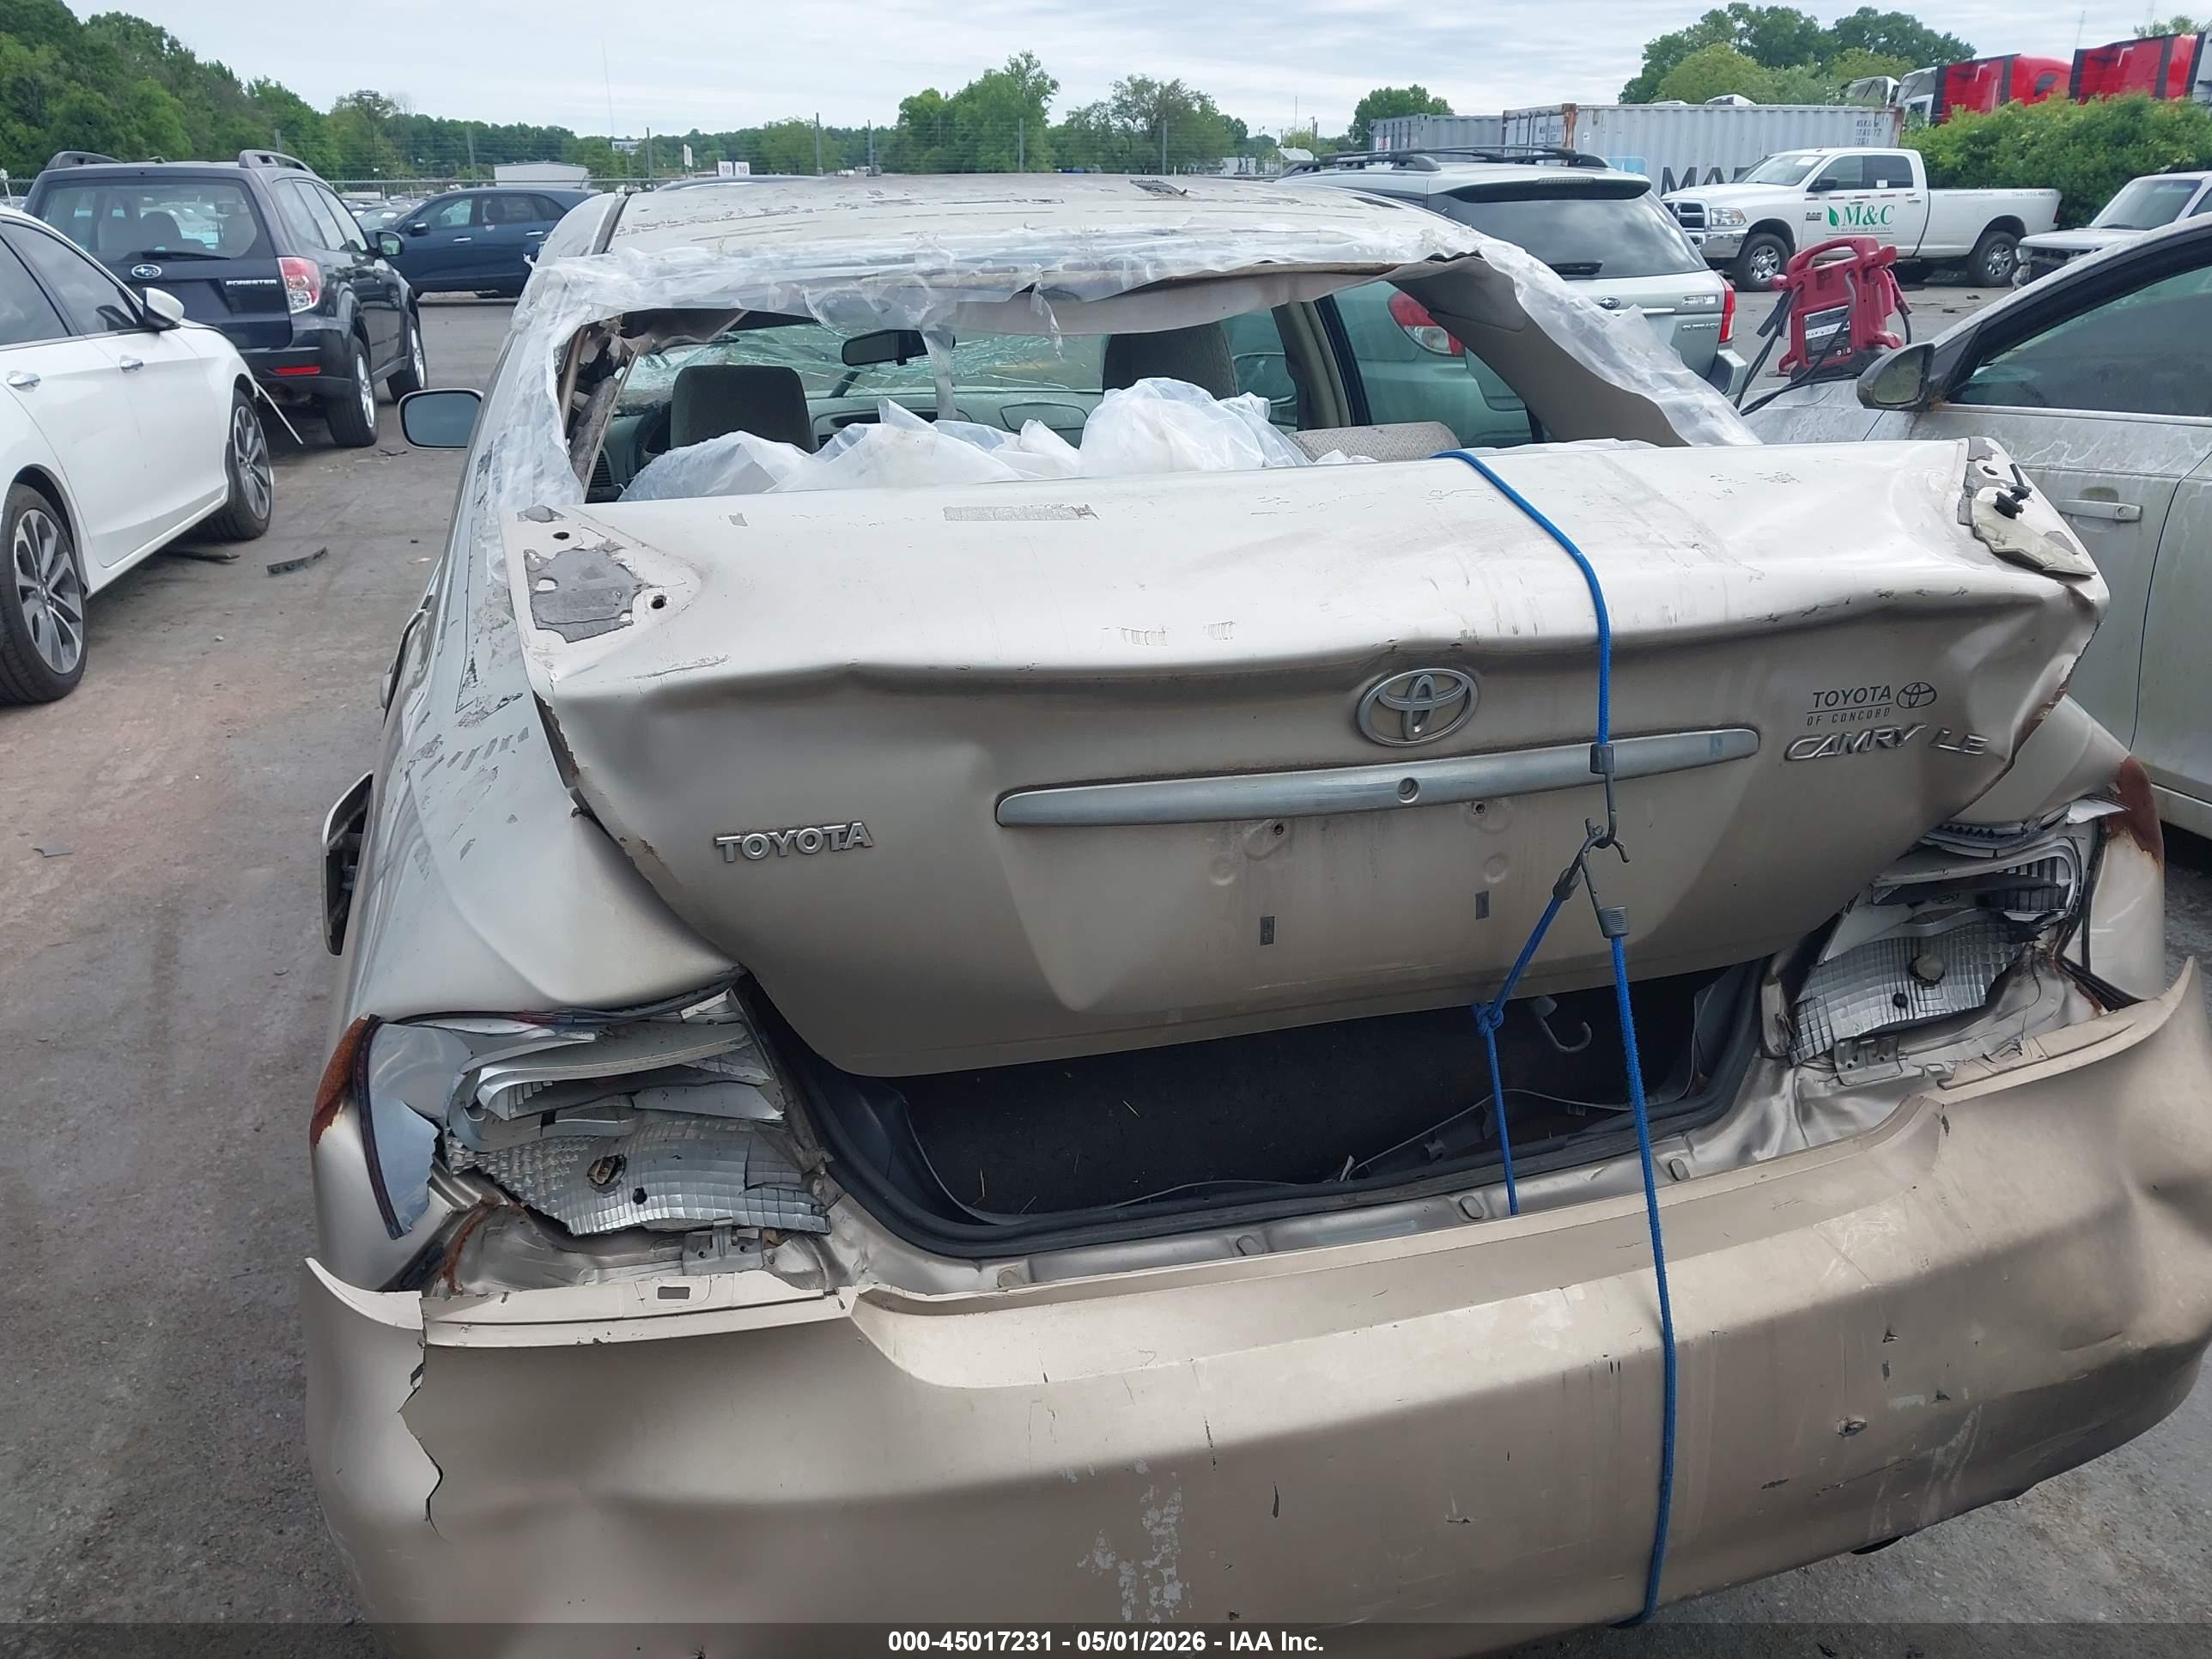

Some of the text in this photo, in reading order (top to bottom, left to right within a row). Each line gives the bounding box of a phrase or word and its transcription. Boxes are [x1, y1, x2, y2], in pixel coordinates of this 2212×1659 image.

[721, 165, 731, 173] 10
[738, 165, 747, 173] 10
[1841, 204, 1895, 226] M&C
[1813, 684, 1892, 708] TOYOTA
[1807, 707, 1891, 726] OF CONCORD
[1784, 723, 1990, 761] CAMRY LE
[714, 820, 873, 862] TOYOTA
